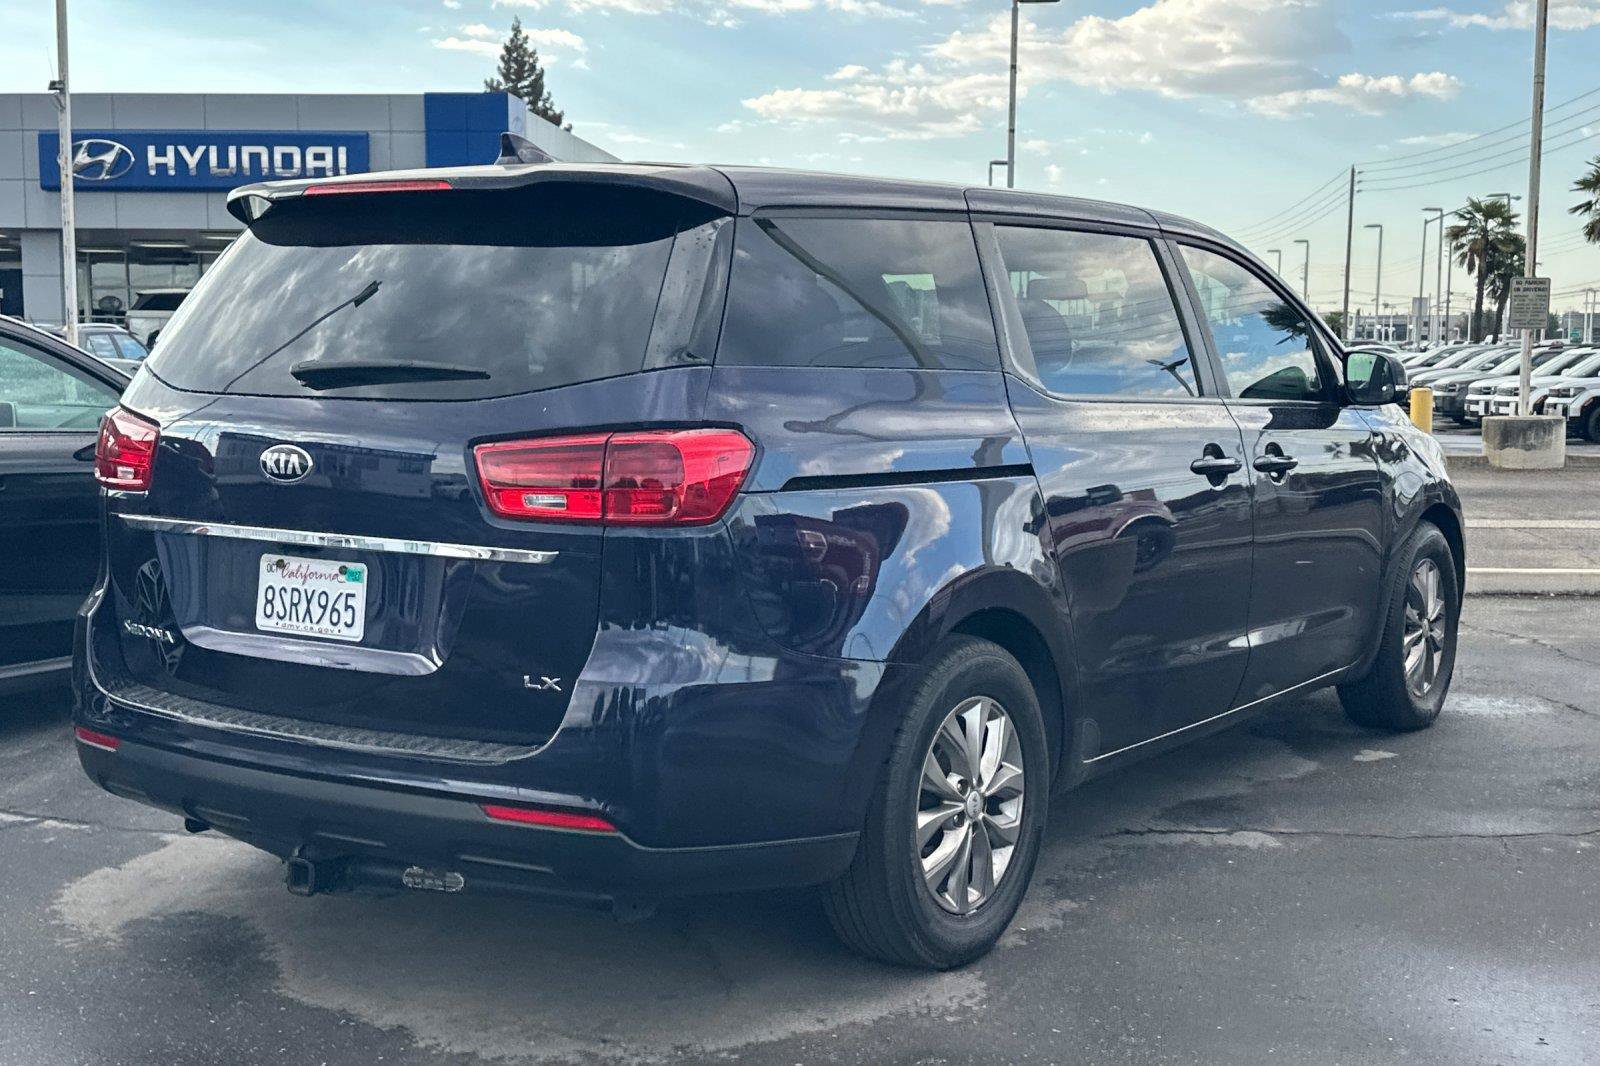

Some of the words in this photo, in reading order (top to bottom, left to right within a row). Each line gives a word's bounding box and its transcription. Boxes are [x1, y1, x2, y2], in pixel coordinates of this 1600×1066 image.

[147, 144, 347, 177] HYUNDAI
[265, 452, 303, 475] KIA
[281, 562, 346, 586] California
[263, 584, 356, 628] 8SRX965
[523, 675, 562, 691] LX
